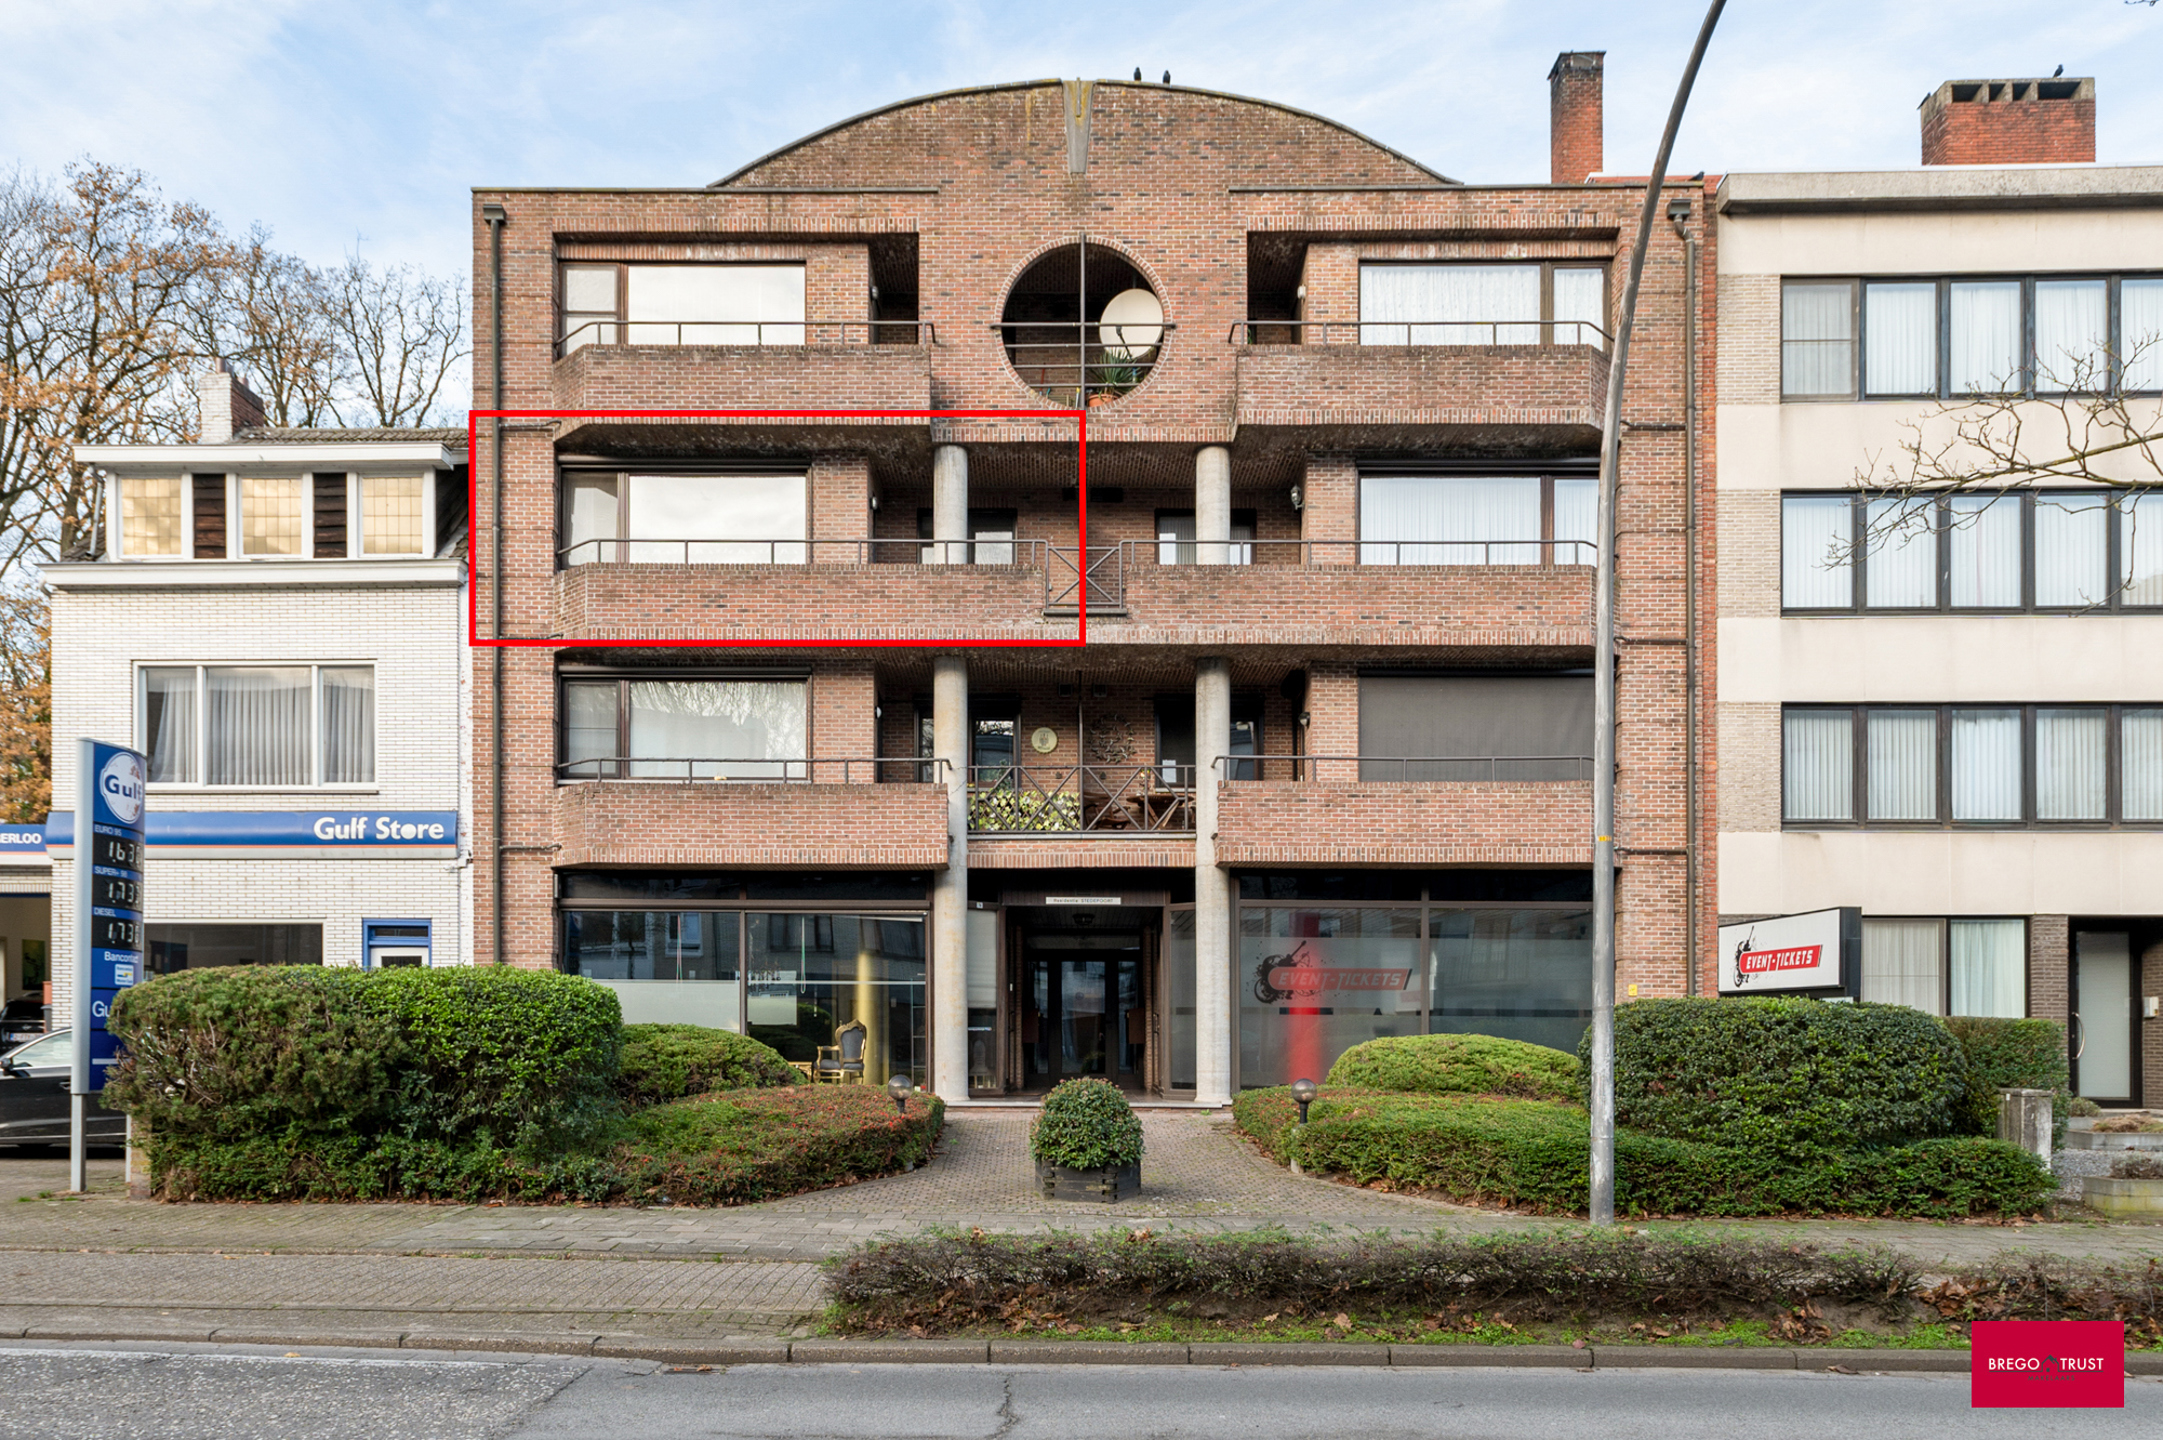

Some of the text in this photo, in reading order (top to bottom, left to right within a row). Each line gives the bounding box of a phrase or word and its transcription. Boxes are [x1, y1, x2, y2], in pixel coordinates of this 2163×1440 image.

[0, 832, 42, 844] ERLOO
[313, 816, 444, 840] Gulf Store
[1746, 949, 1814, 972] EVENT-TICKETS
[1278, 972, 1403, 990] EVENT-TICKETS
